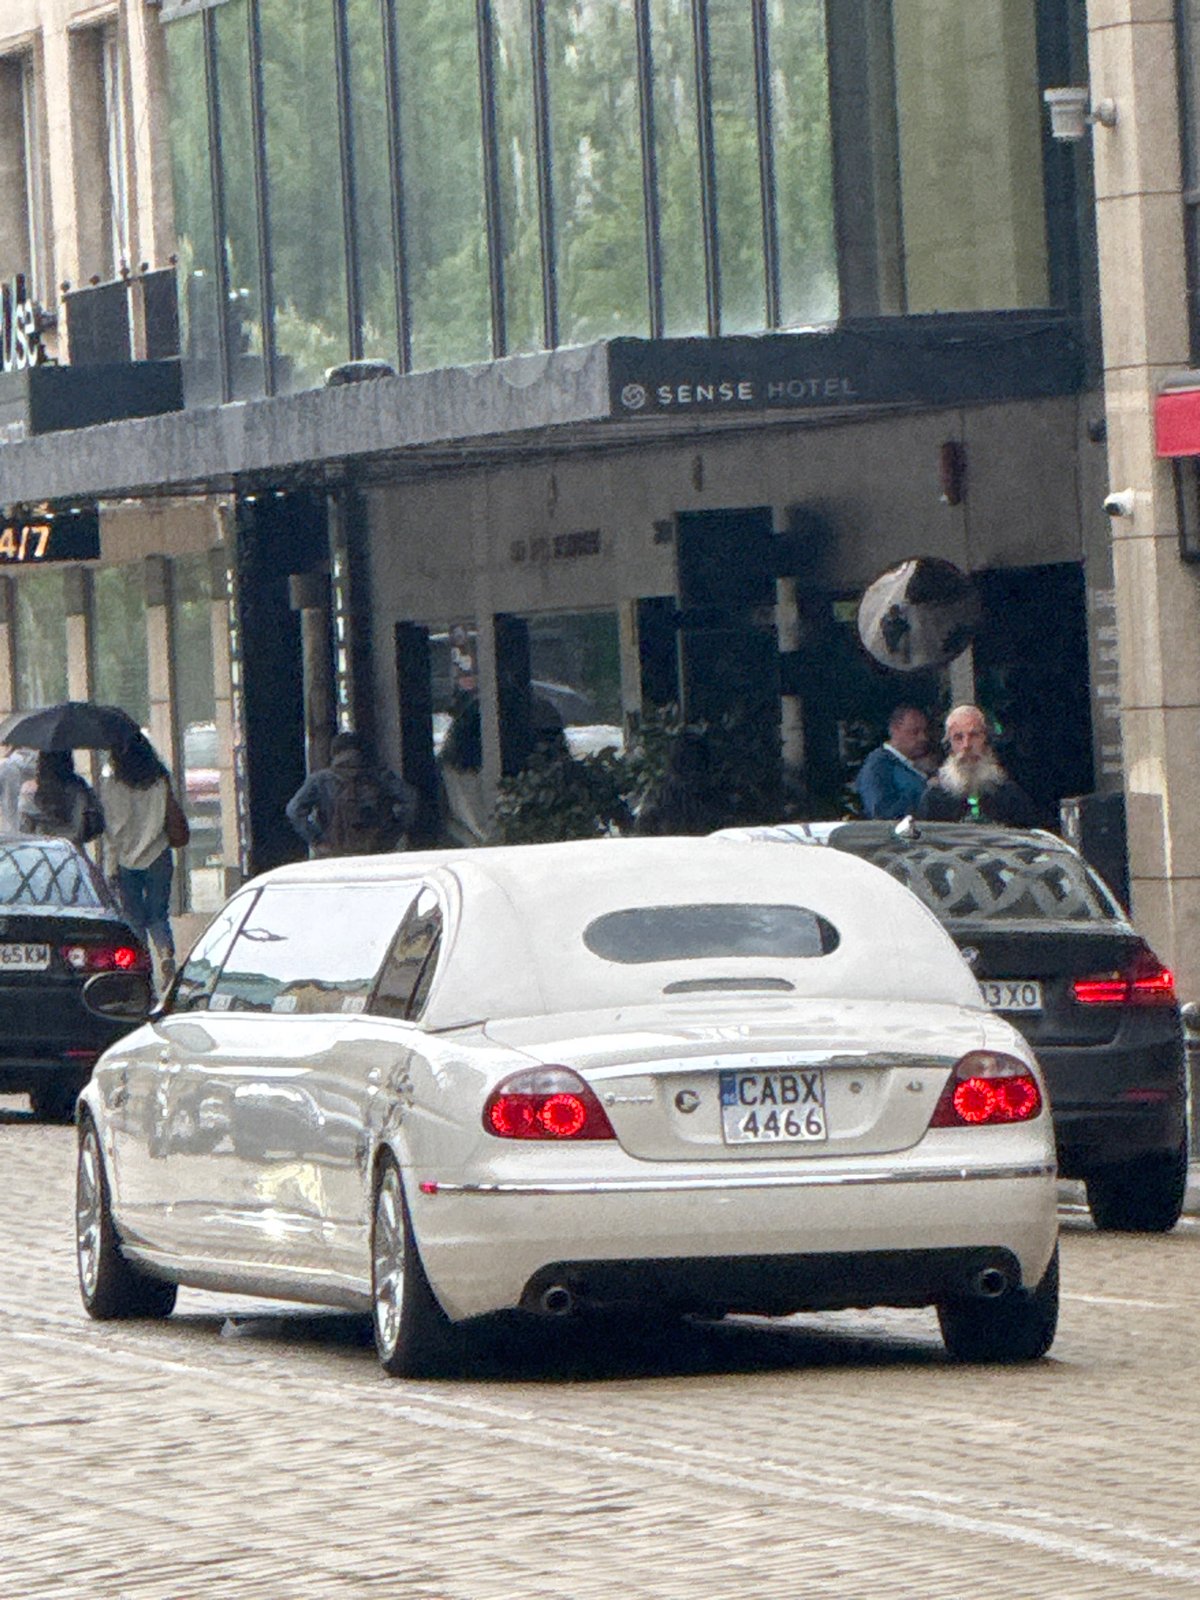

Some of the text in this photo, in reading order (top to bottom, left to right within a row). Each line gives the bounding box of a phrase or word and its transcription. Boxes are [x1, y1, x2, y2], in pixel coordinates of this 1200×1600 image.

[657, 377, 857, 404] SENSE HOTEL
[0, 525, 50, 560] 4/7
[738, 1073, 820, 1106] CABX
[743, 1108, 823, 1138] 4466
